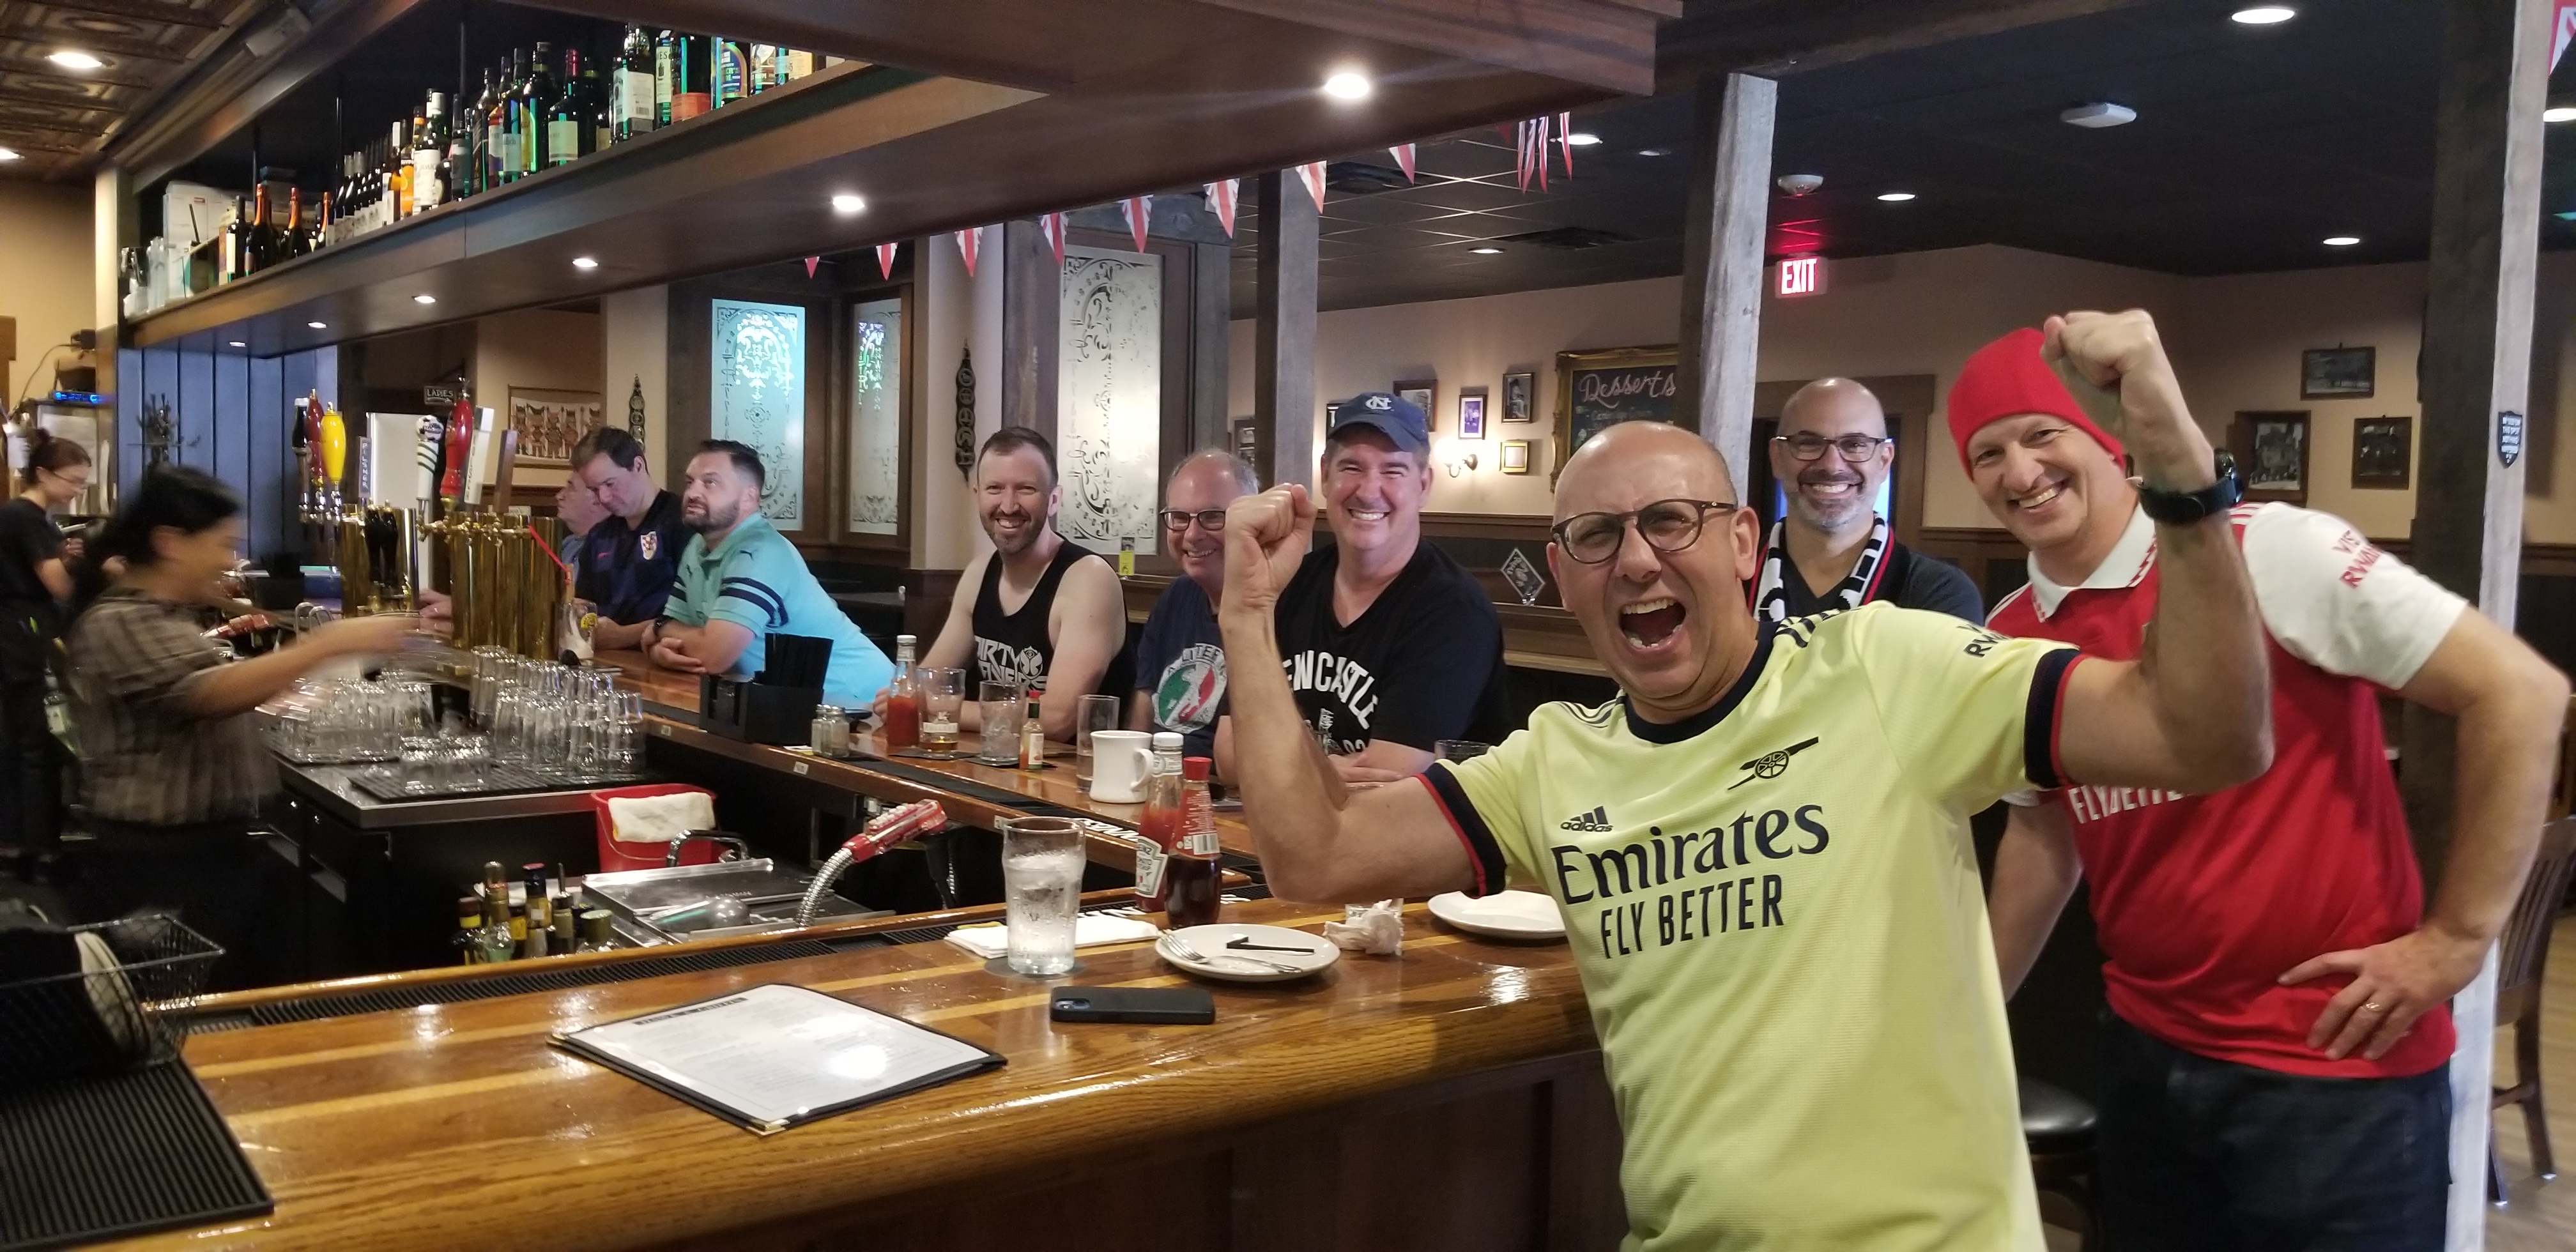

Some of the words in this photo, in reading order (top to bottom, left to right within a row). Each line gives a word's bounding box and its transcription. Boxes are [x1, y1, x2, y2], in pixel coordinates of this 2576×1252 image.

[1781, 258, 1817, 294] EXIT
[427, 388, 454, 397] LADIES
[1579, 370, 1676, 409] Desserts
[2068, 785, 2110, 823] FLY
[1560, 820, 1614, 832] adidas
[1551, 805, 1830, 905] Emirates
[1600, 901, 1645, 959] FLY
[1659, 874, 1784, 947] BETTER
